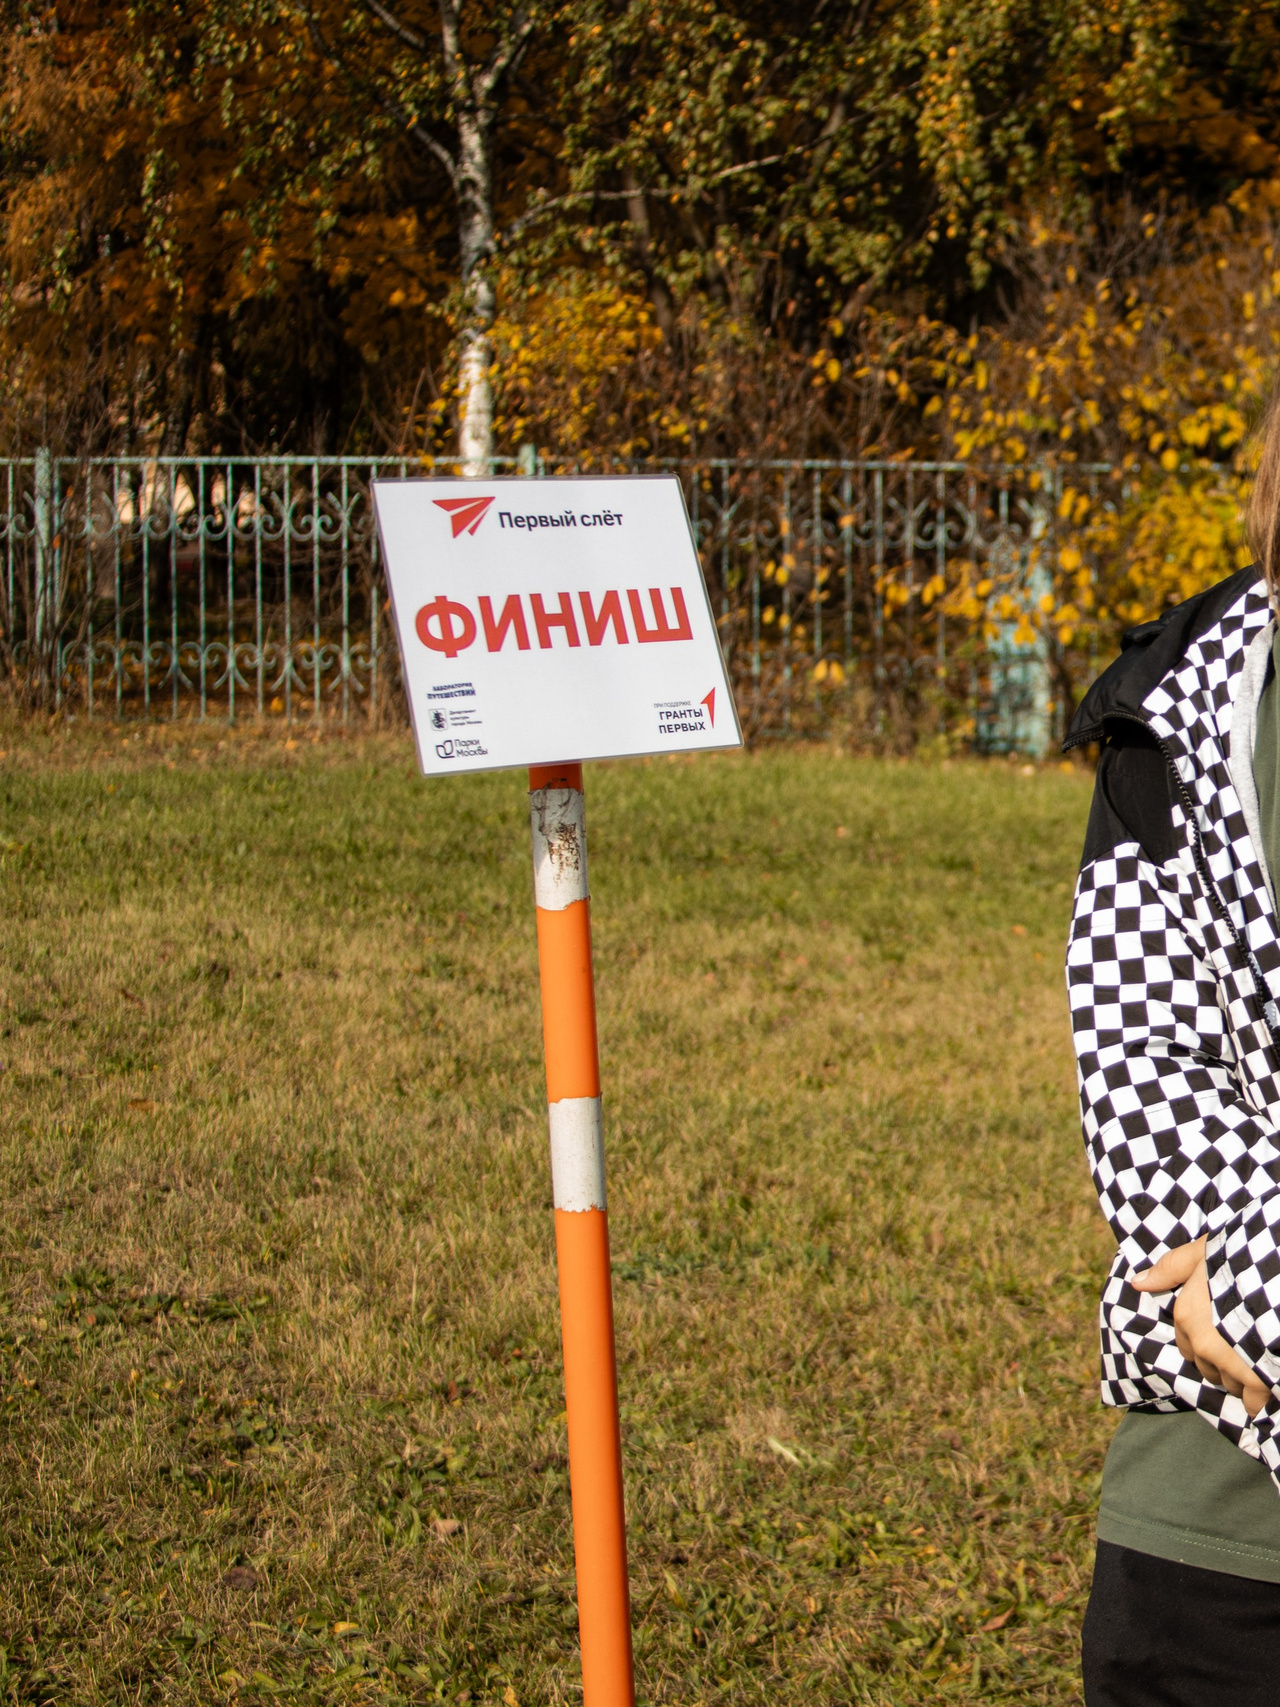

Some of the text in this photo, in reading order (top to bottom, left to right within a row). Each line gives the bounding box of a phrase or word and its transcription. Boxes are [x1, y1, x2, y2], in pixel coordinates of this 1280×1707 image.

[498, 510, 624, 531] Первый слёт
[415, 586, 694, 658] ФИНИШ
[427, 688, 476, 699] ПУТЕШЕСТВИЙ
[659, 708, 703, 720] ГРАНТЫ
[658, 721, 706, 734] ПЕРВЫХ
[454, 738, 480, 750] Парки
[456, 746, 488, 757] Москвы
